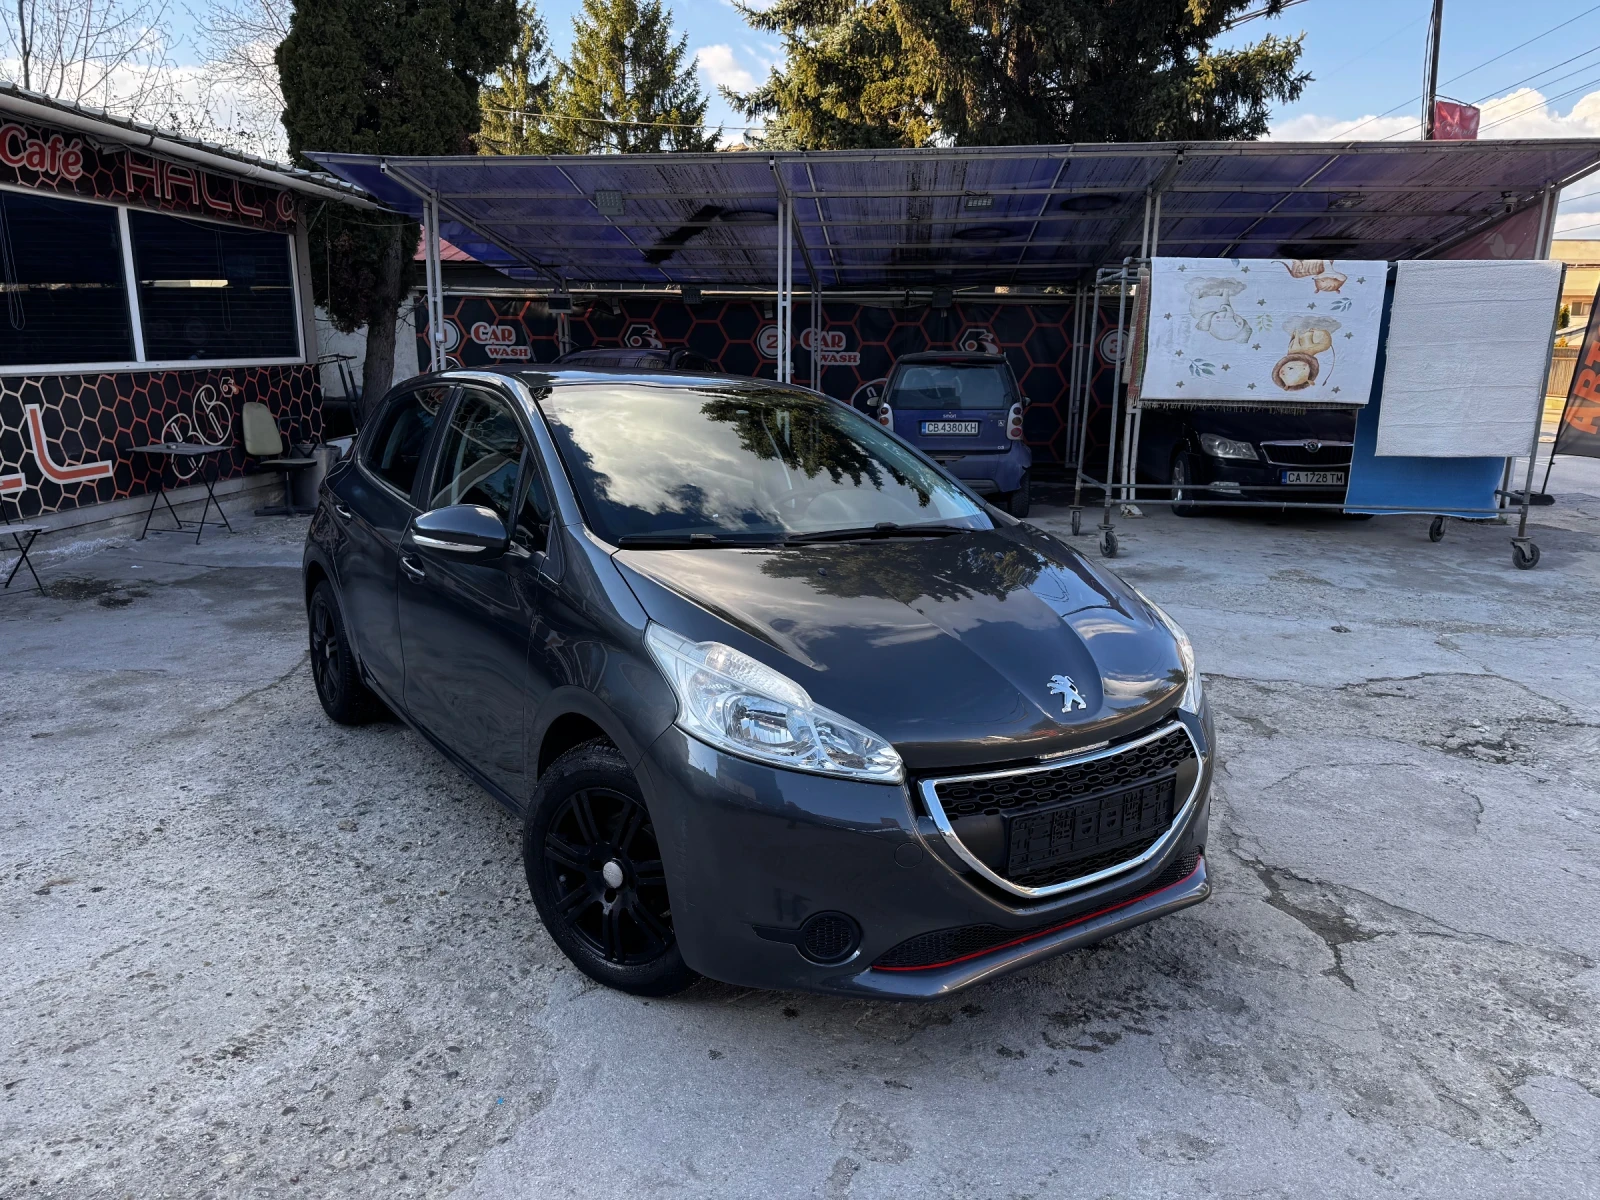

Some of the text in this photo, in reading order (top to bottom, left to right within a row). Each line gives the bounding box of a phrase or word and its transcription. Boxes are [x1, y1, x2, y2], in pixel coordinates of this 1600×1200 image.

[0, 123, 83, 180] Café
[125, 151, 263, 217] HALL
[472, 323, 515, 343] CAR
[801, 329, 845, 349] CAR
[766, 334, 780, 349] 2
[486, 347, 530, 358] WASH
[817, 353, 859, 364] WASH
[927, 423, 977, 433] CB 4380 KH
[1288, 472, 1343, 484] CA 1728 TM
